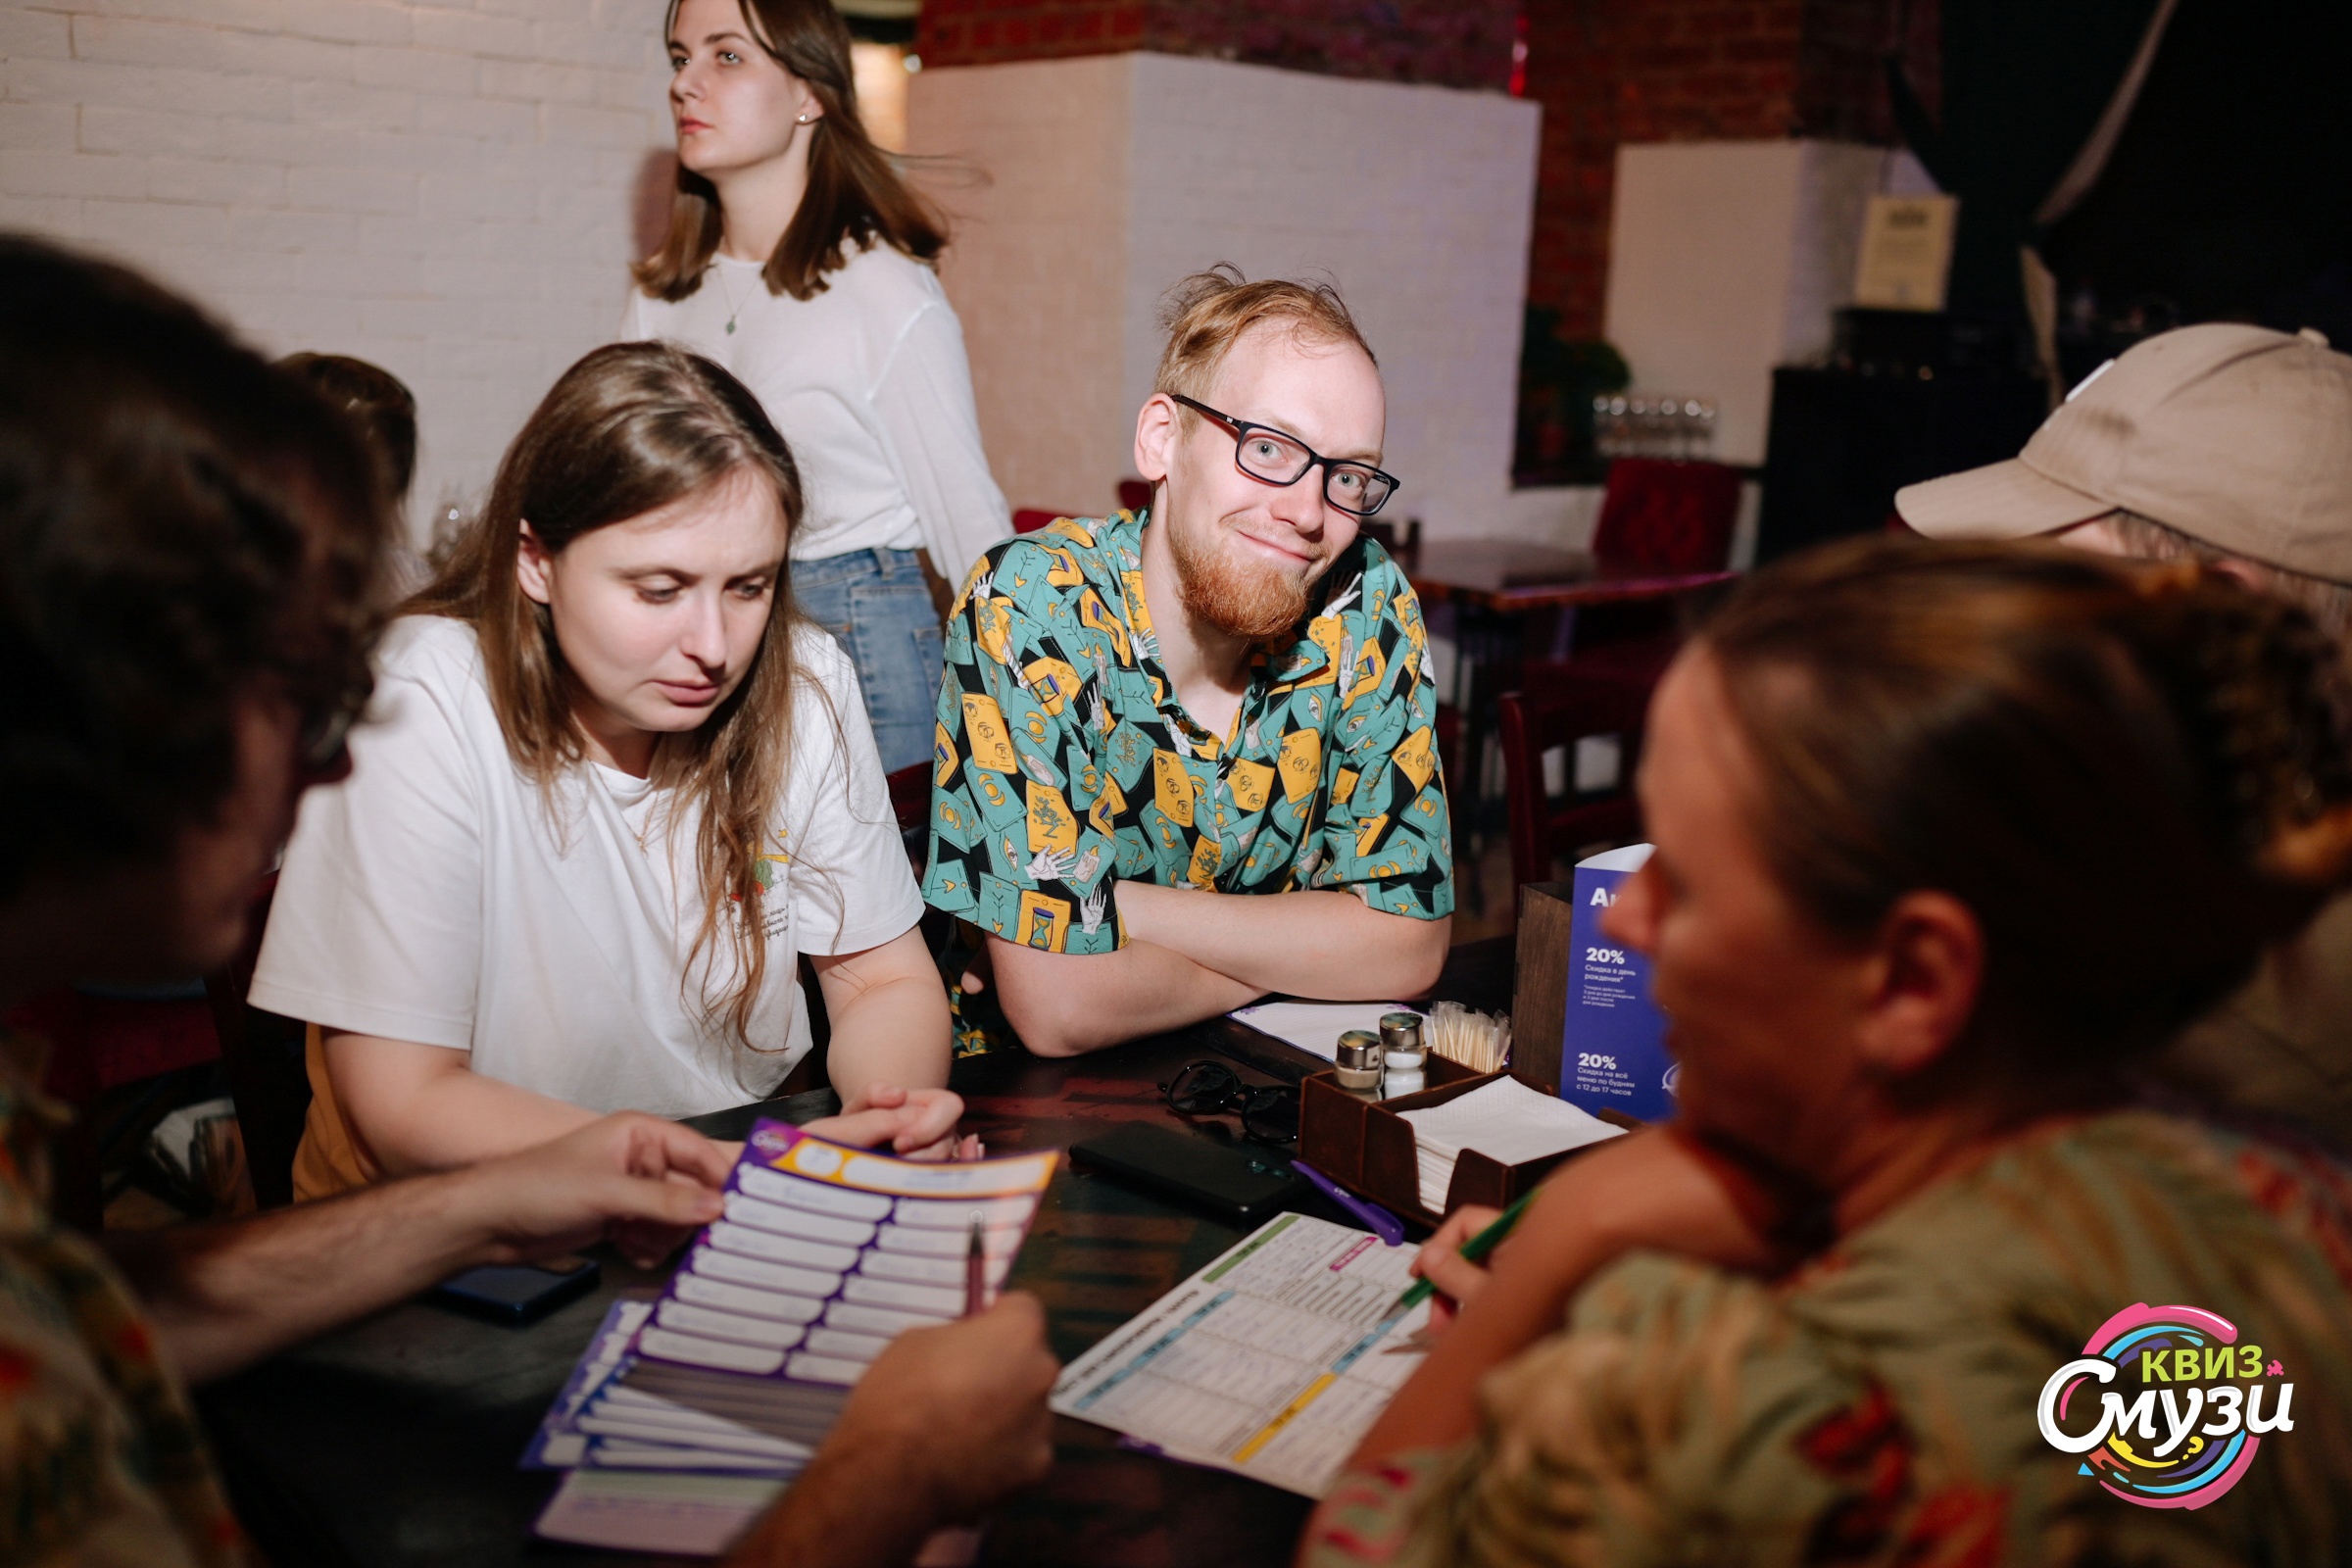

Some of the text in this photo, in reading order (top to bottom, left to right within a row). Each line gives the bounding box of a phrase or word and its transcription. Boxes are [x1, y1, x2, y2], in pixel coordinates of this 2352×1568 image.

[1586, 947, 1625, 964] 20%
[1585, 964, 1611, 973] Скидка
[1578, 1053, 1617, 1070] 20%
[1577, 1067, 1603, 1077] Скидка
[1608, 1079, 1635, 1088] будням
